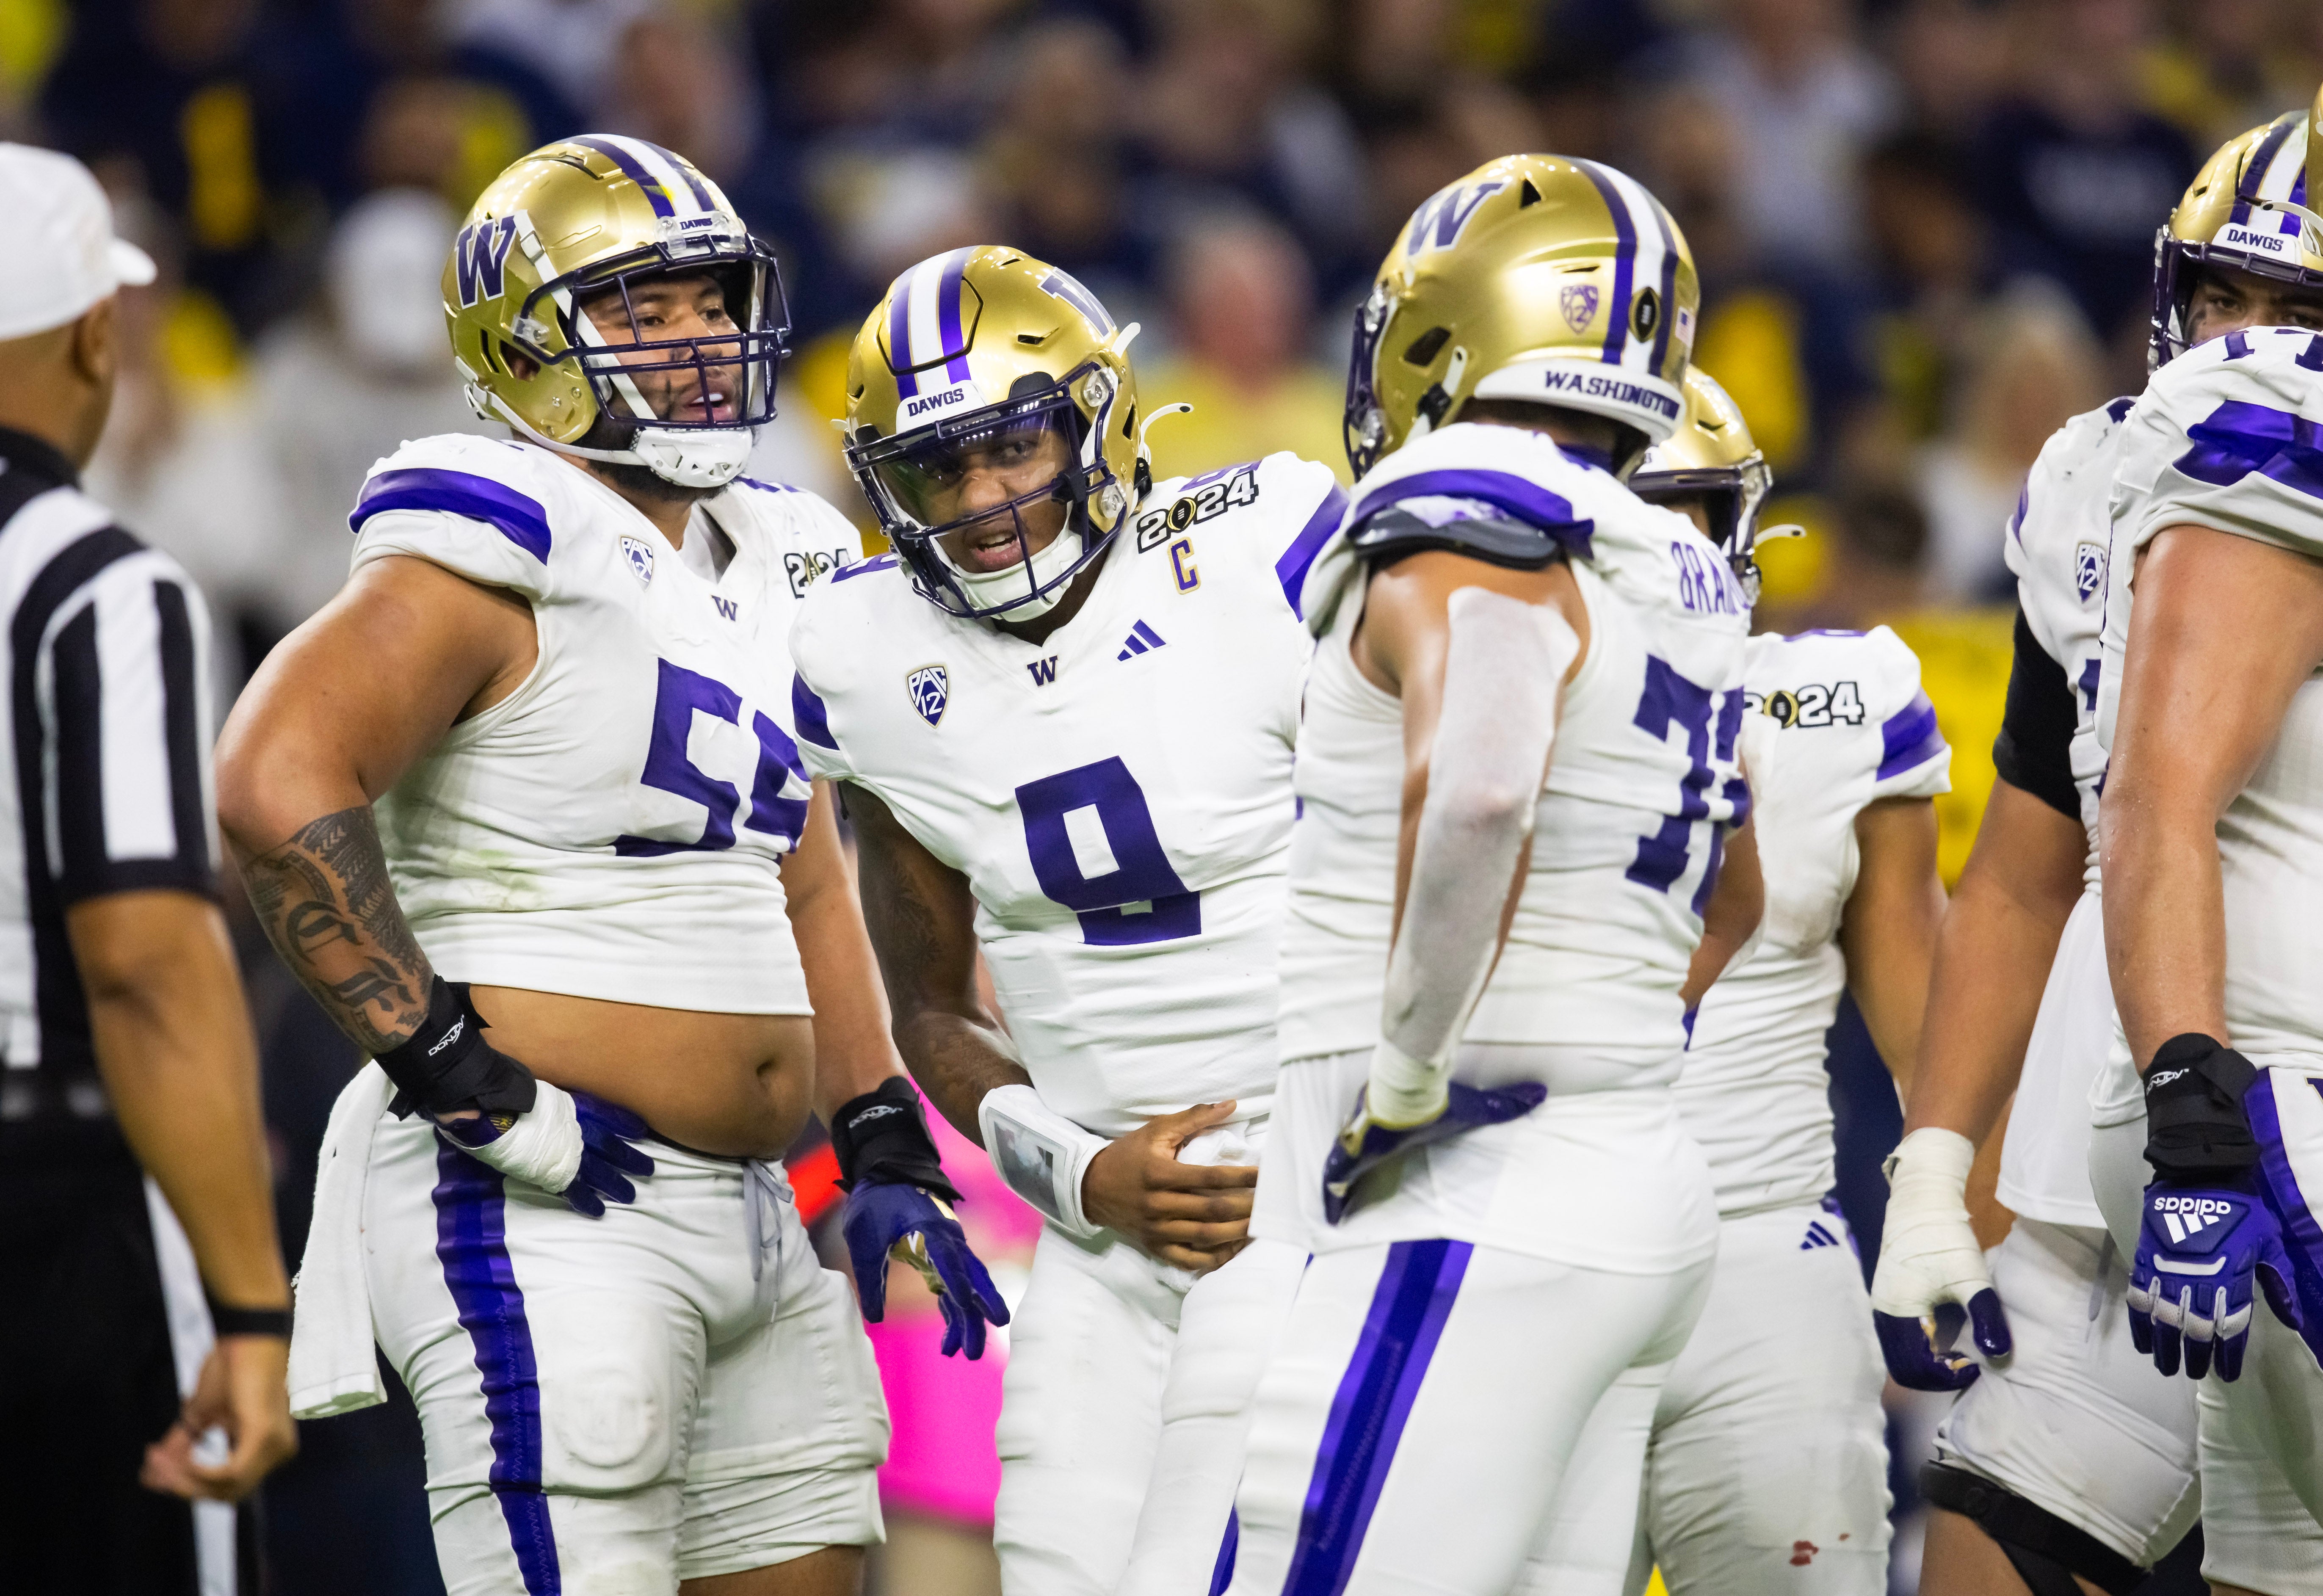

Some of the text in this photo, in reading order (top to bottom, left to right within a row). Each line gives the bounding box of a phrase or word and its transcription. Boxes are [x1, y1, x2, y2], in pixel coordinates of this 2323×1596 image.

[455, 210, 521, 309] W
[2226, 228, 2284, 252] DAWGS
[907, 387, 965, 417] DAWGS
[1136, 469, 1260, 555] 2024
[621, 537, 653, 576] PAC
[1167, 536, 1202, 595] C
[711, 594, 738, 622] W
[908, 667, 947, 708] PAC
[1028, 655, 1058, 688] W
[921, 691, 943, 717] 12
[1015, 755, 1202, 946] 9
[428, 1018, 464, 1057] DONJOY
[2154, 1197, 2231, 1215] adidas
